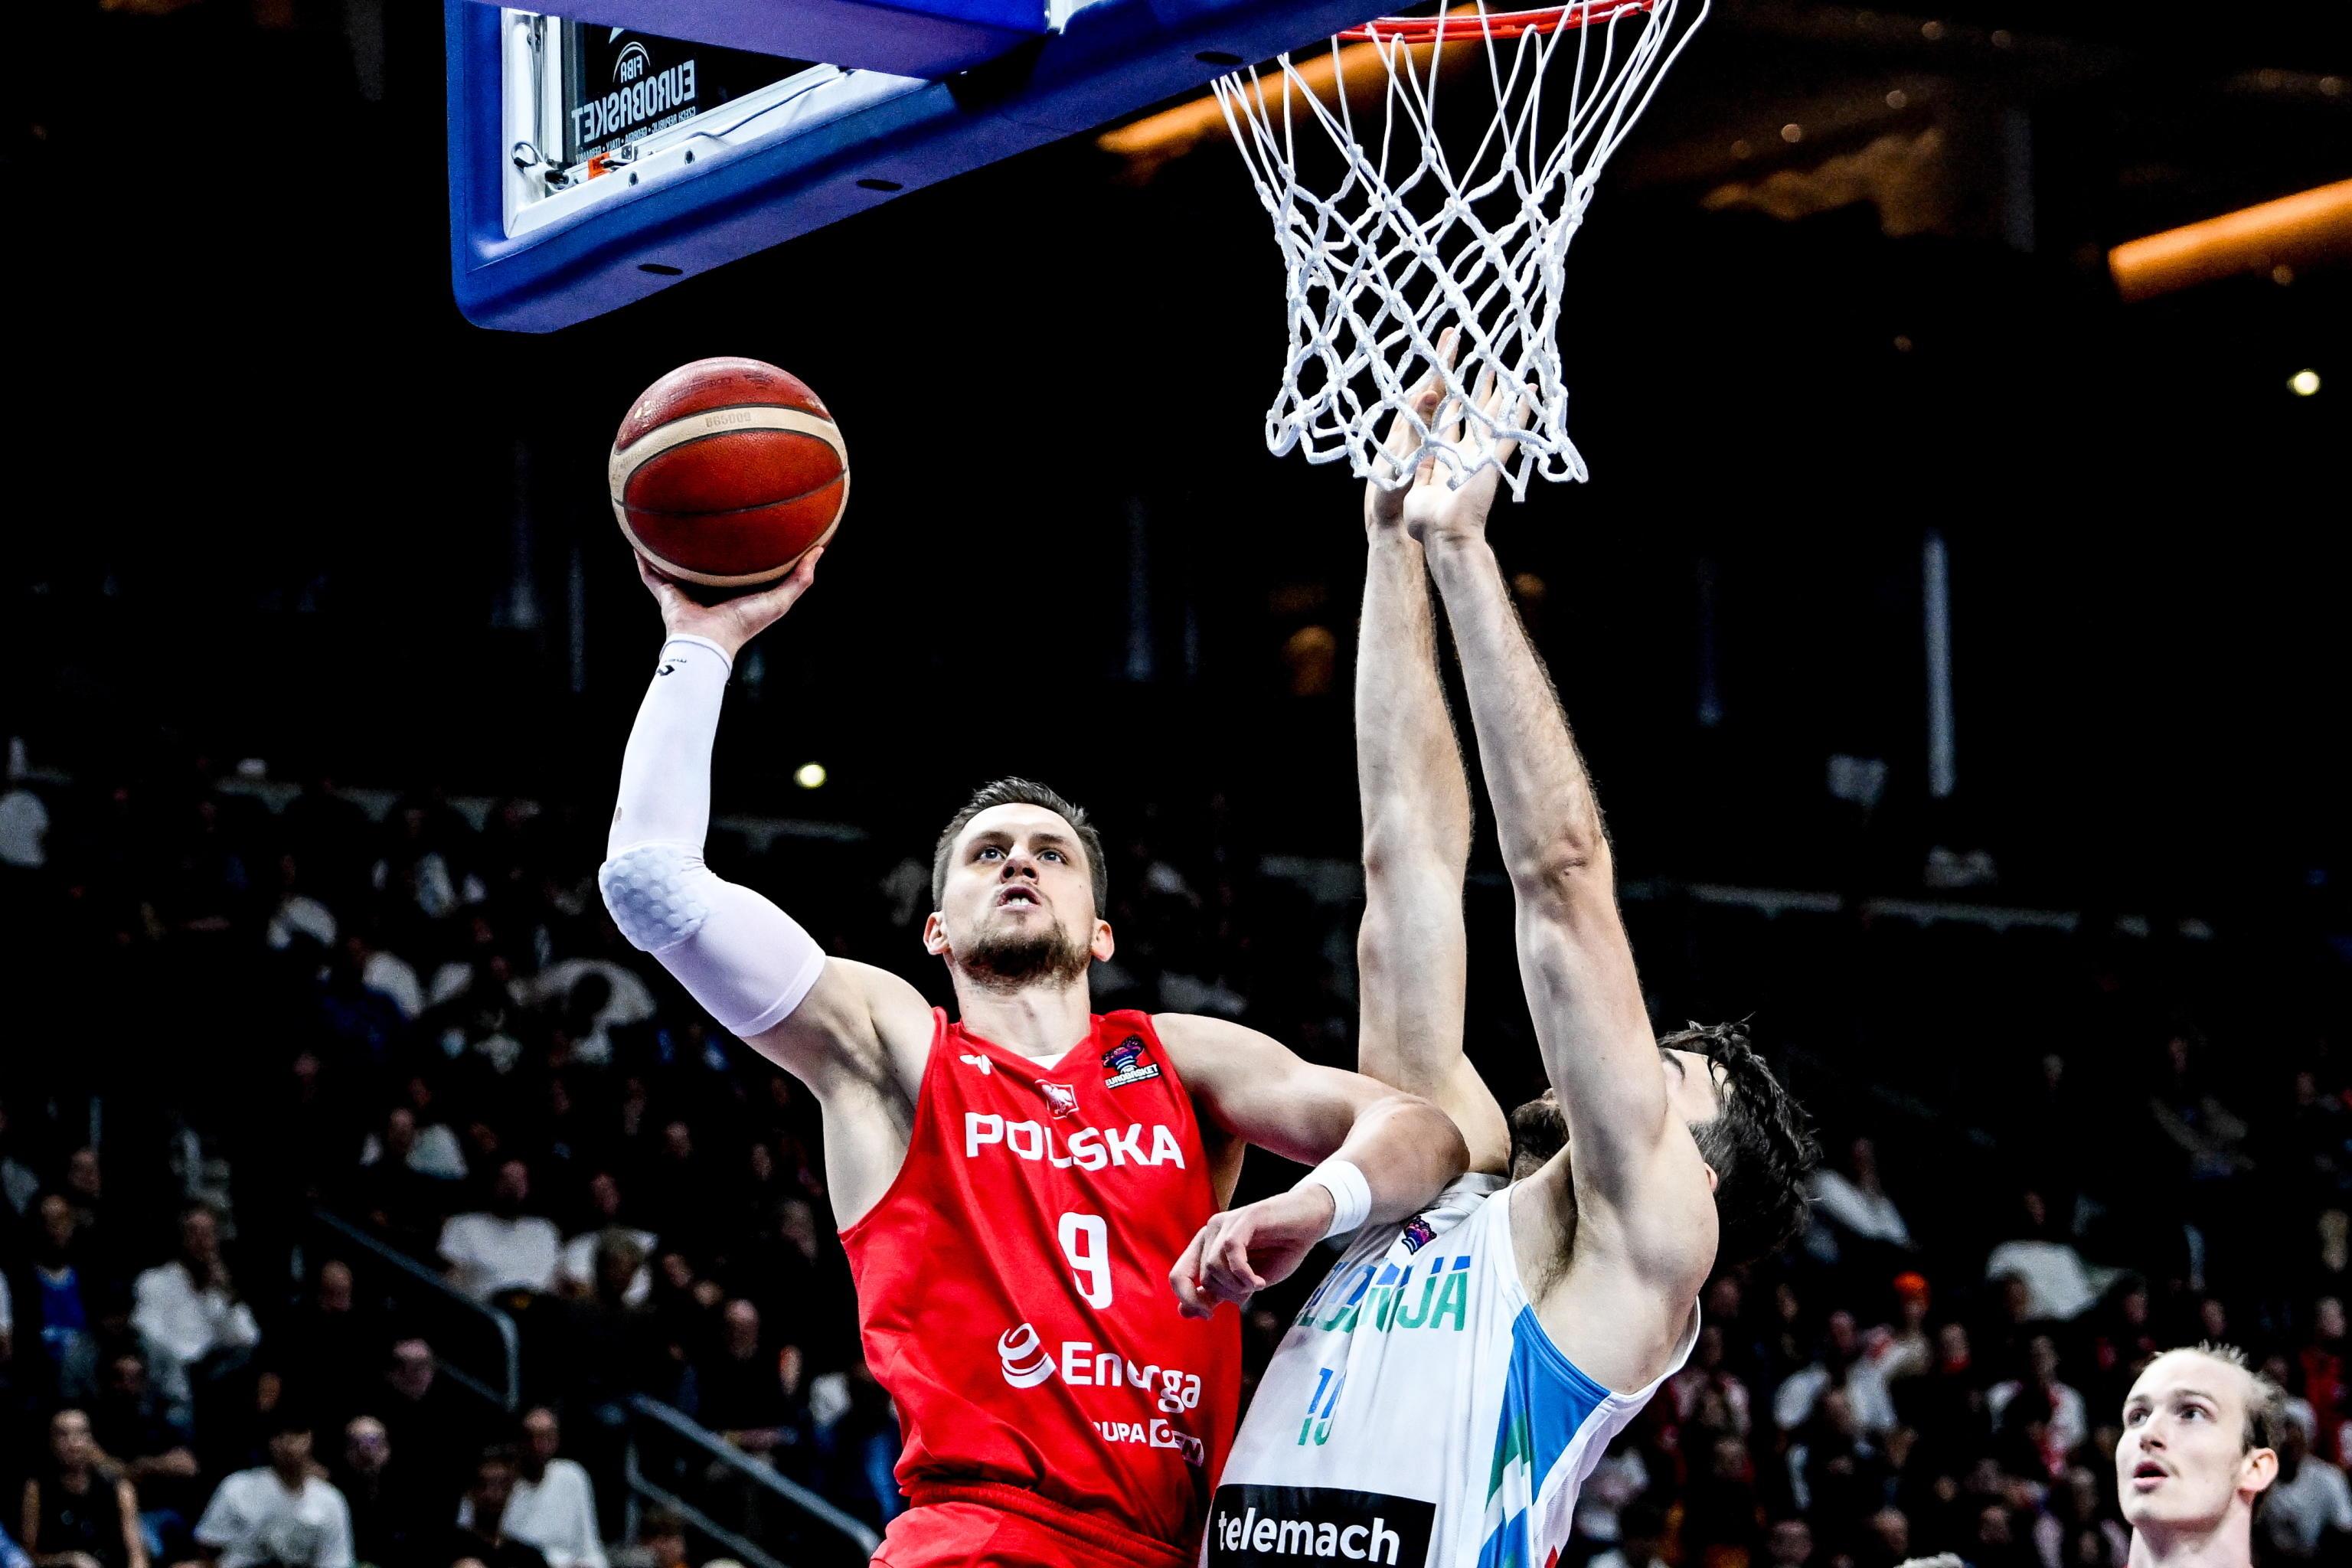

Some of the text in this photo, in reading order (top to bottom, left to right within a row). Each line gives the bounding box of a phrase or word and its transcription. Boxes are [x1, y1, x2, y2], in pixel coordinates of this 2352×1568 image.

[965, 1112, 1185, 1171] POLSKA
[1057, 1211, 1113, 1309] 9
[1218, 1507, 1400, 1566] telemach
